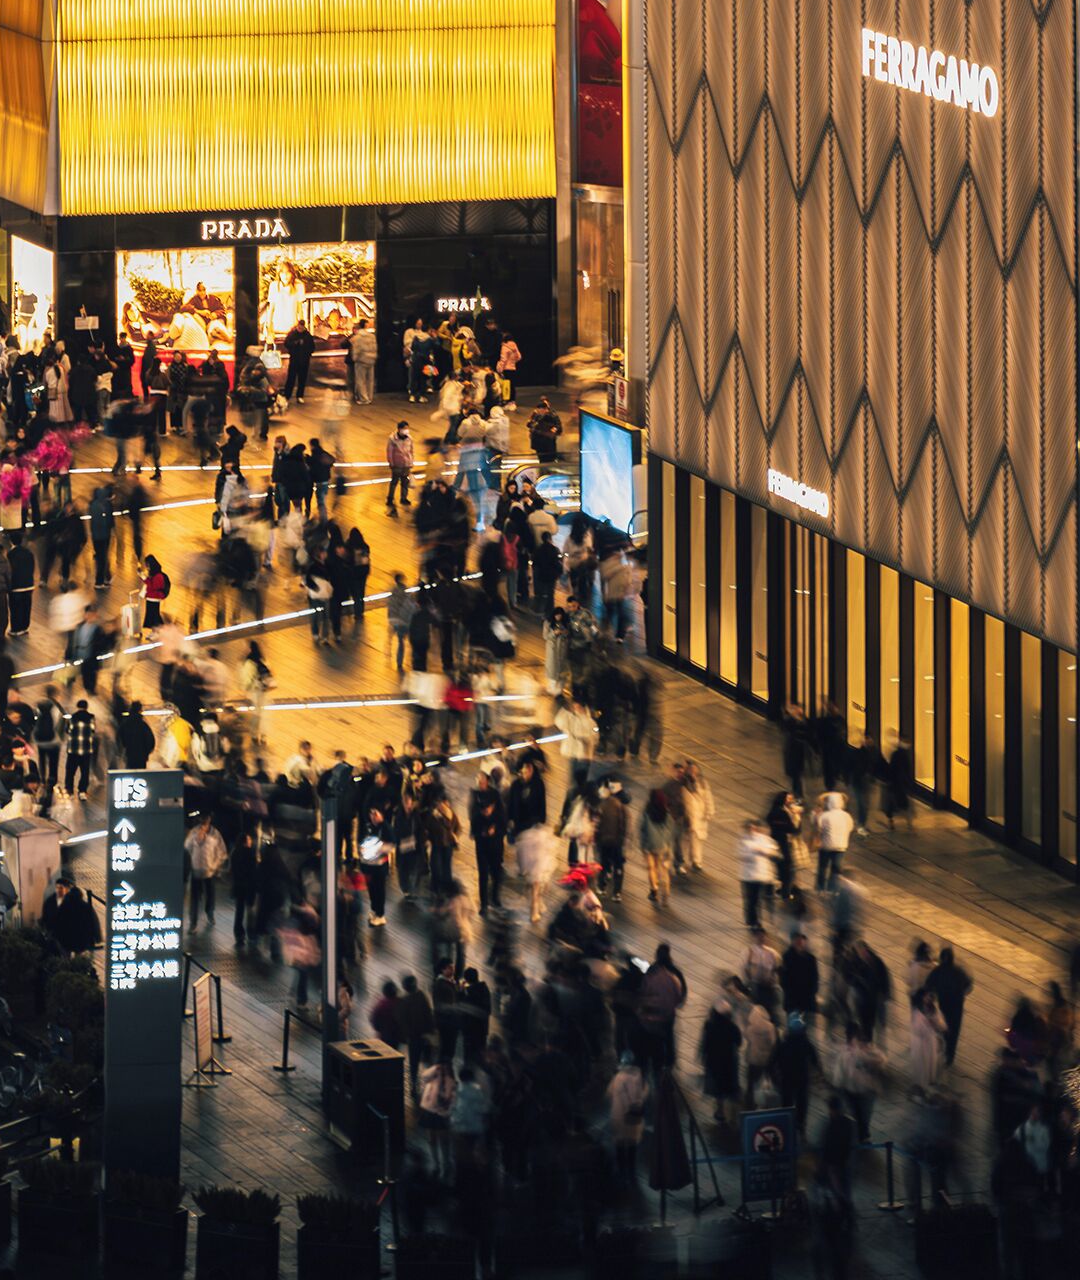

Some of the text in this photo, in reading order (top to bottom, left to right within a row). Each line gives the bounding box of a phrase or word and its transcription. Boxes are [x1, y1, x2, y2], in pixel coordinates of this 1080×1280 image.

[862, 28, 999, 118] FERRAGAMO
[201, 219, 290, 240] PRADA
[114, 778, 148, 801] IFS
[111, 950, 119, 961] 2
[110, 978, 119, 990] 3
